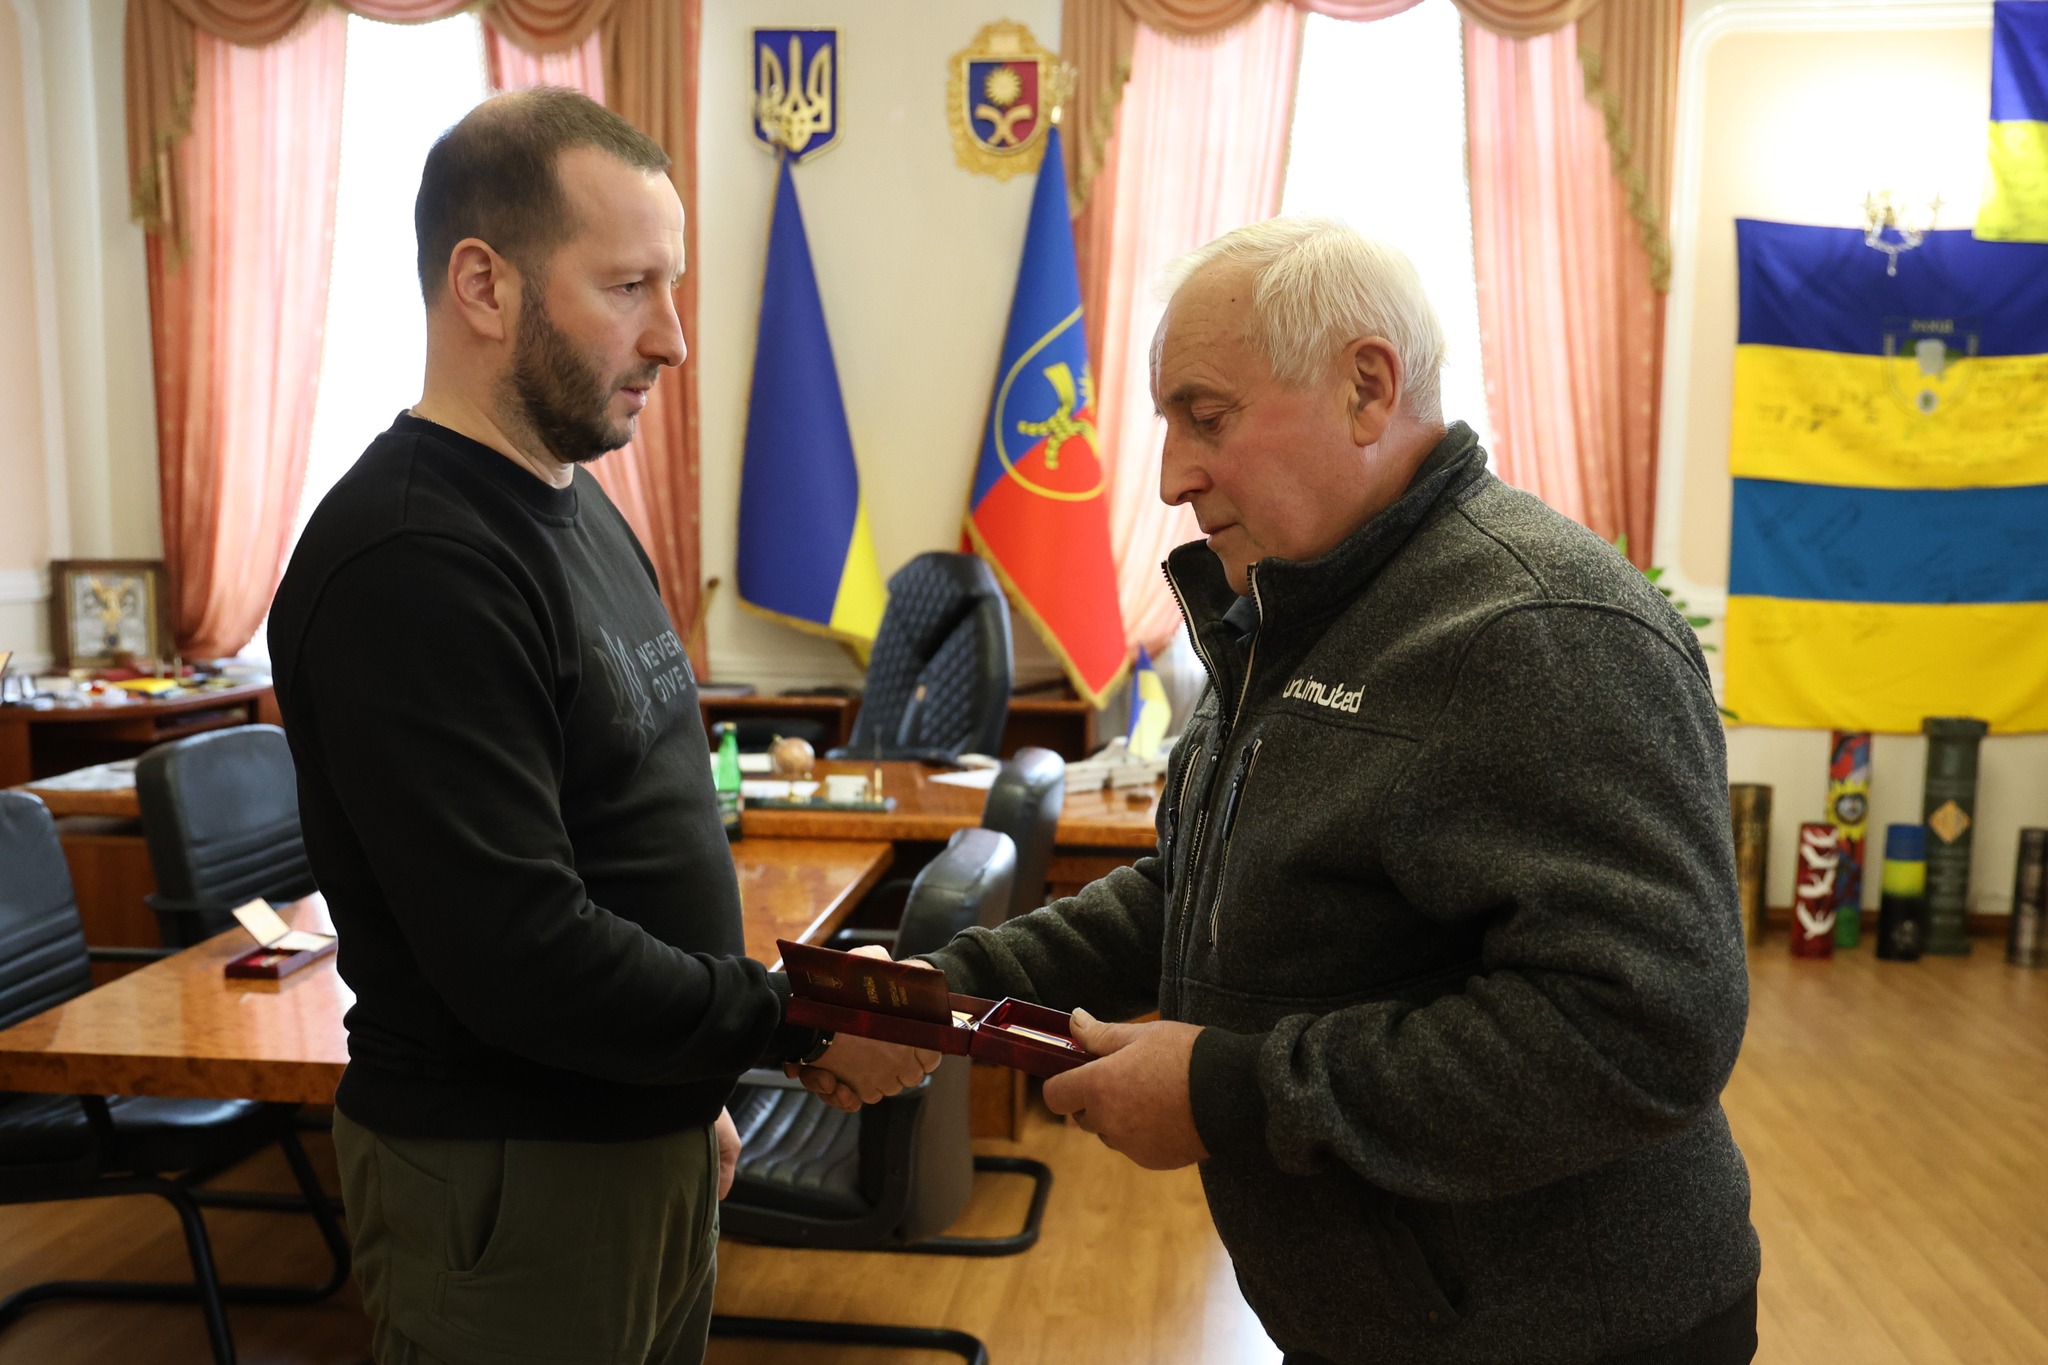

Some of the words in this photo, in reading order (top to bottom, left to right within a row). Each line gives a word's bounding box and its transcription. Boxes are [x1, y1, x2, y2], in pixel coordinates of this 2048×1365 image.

[635, 630, 682, 672] NEVER
[652, 665, 686, 704] GIVE
[682, 659, 695, 684] U
